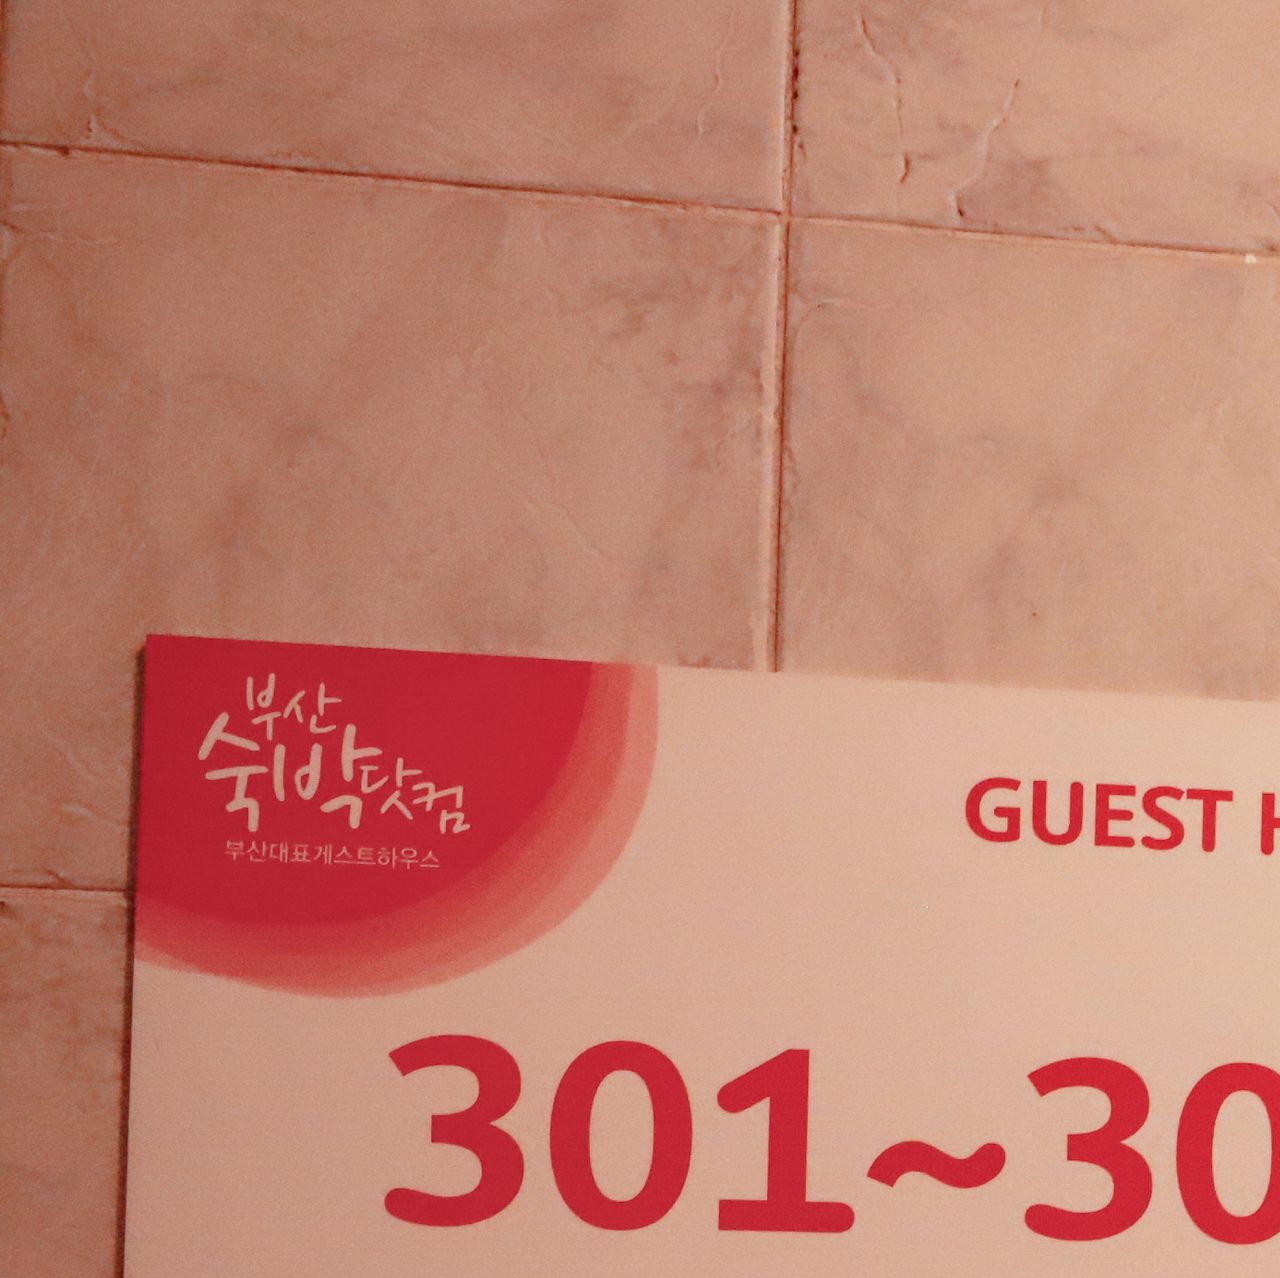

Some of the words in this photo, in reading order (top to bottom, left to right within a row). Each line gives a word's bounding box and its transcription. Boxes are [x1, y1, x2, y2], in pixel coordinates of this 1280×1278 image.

[246, 672, 343, 741] 부산
[965, 776, 1234, 853] GUEST
[223, 839, 441, 870] 부산대표게스트하우스
